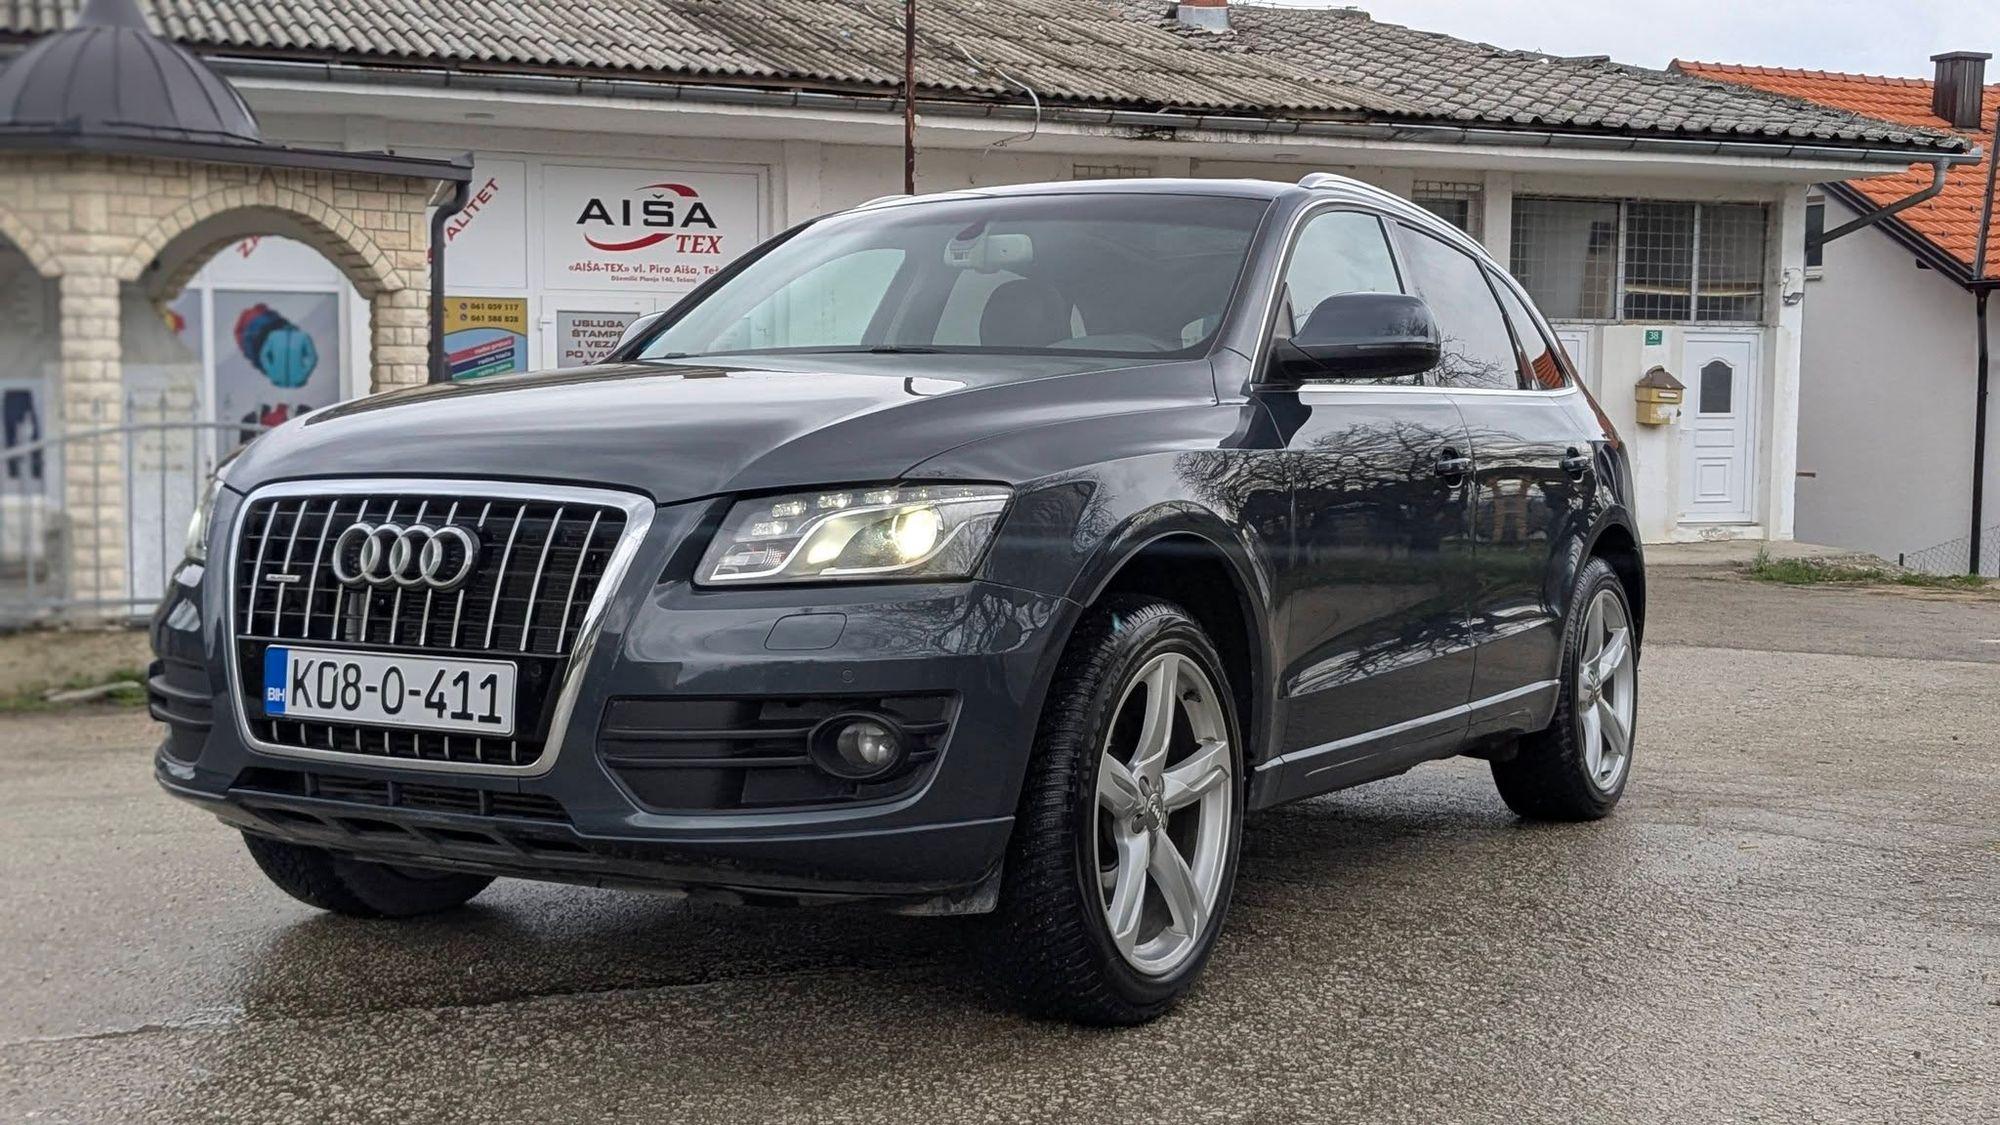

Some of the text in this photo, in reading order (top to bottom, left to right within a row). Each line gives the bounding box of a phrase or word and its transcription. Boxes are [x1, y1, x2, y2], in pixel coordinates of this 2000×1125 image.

[443, 178, 499, 248] ALITET
[576, 194, 718, 229] AIŠA
[676, 234, 723, 254] TEX
[633, 264, 646, 273] vl.
[650, 264, 670, 274] Piro
[572, 319, 624, 328] USLUGA
[1649, 331, 1659, 340] 38
[566, 350, 584, 358] PO
[268, 687, 286, 702] BIH
